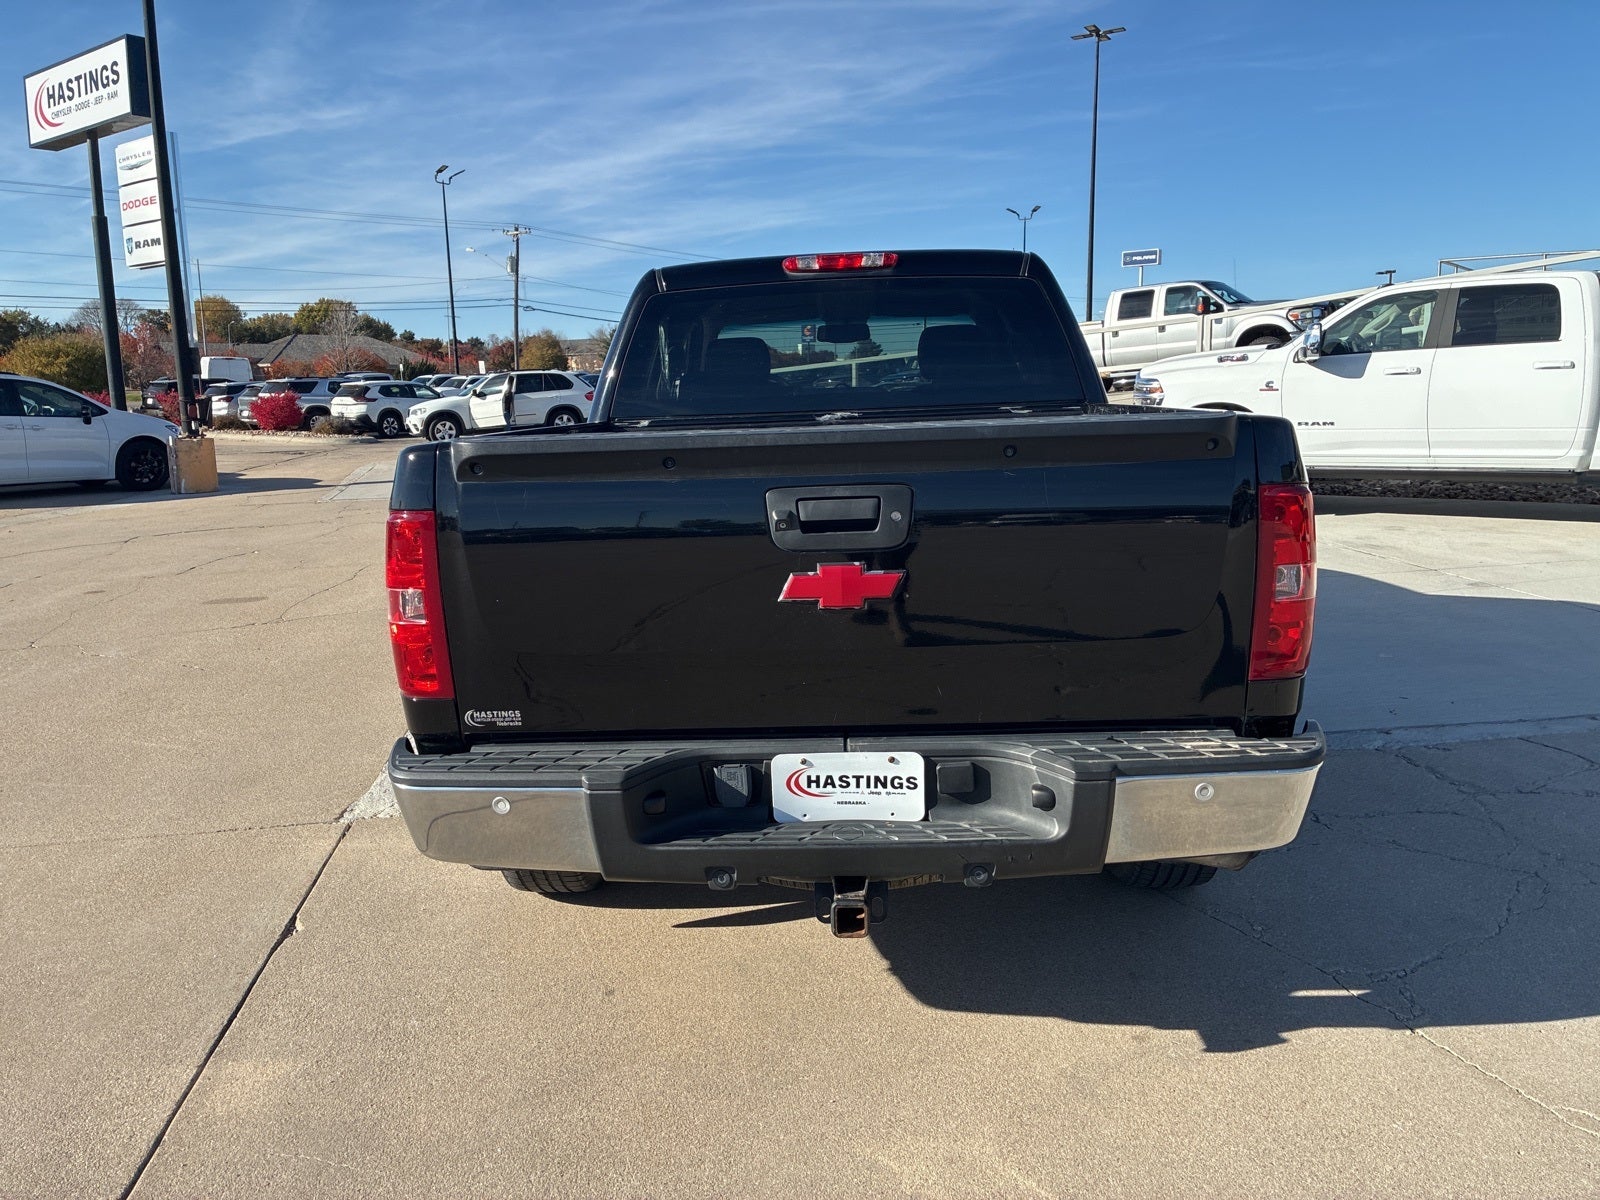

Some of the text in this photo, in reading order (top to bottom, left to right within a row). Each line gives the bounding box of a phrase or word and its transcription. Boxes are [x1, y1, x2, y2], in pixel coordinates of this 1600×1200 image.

[46, 60, 120, 108] HASTINGS
[51, 90, 118, 120] CHRYSLER DODGE JEEP RAM
[118, 150, 151, 164] CHRYSLER
[122, 196, 157, 211] DODGE
[135, 238, 161, 249] RAM
[806, 775, 918, 790] HASTINGS
